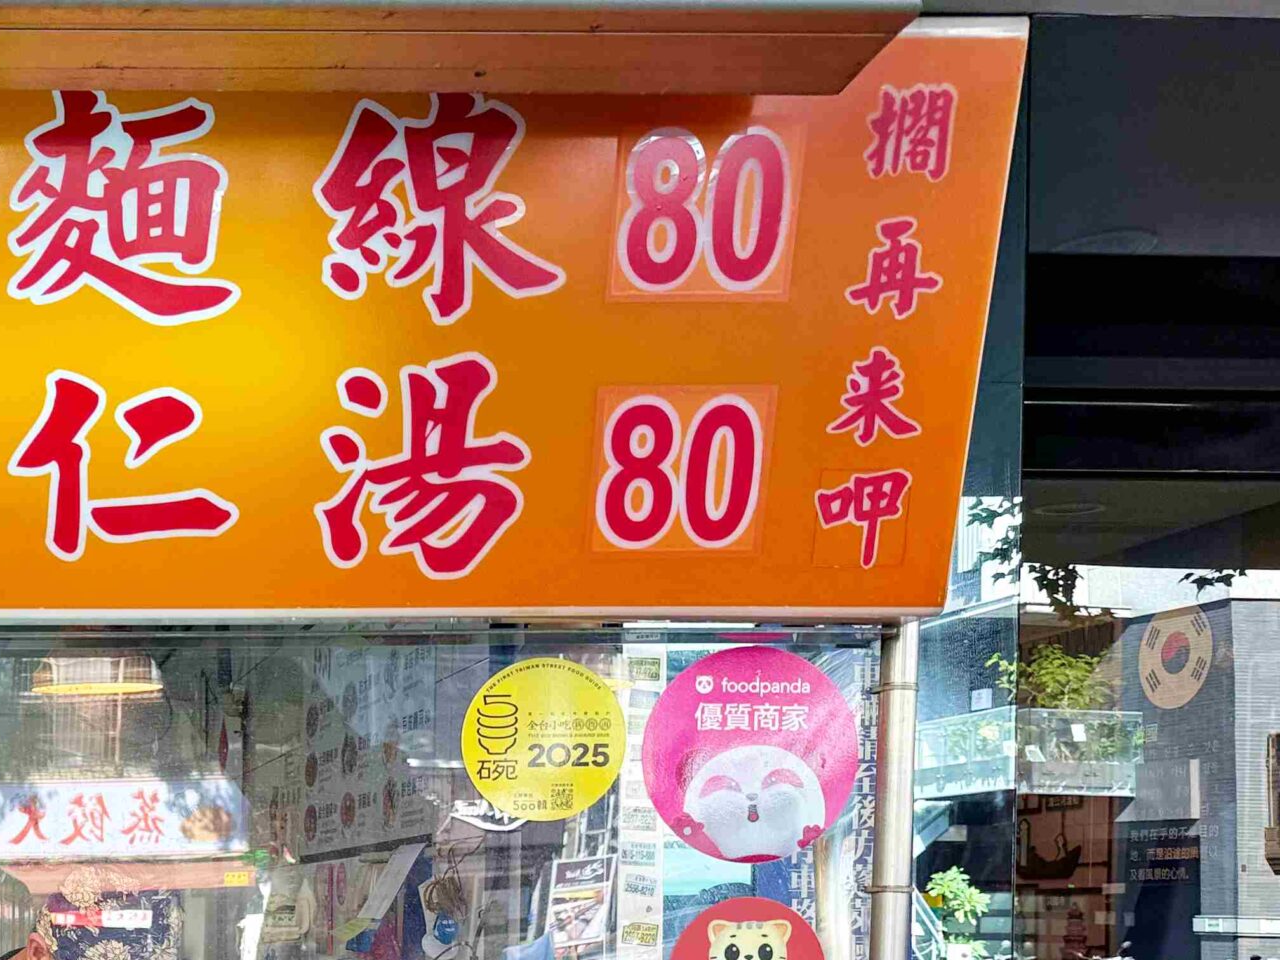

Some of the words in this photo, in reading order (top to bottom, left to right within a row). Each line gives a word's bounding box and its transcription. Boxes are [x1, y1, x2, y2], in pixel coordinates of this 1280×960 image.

[617, 126, 792, 292] 80
[595, 394, 763, 549] 80
[514, 663, 540, 674] TAIWAN
[541, 662, 567, 671] STREET
[721, 677, 812, 696] foodpanda
[694, 701, 811, 732] 優質商家
[527, 743, 610, 768] 2025
[476, 759, 519, 782] 碗
